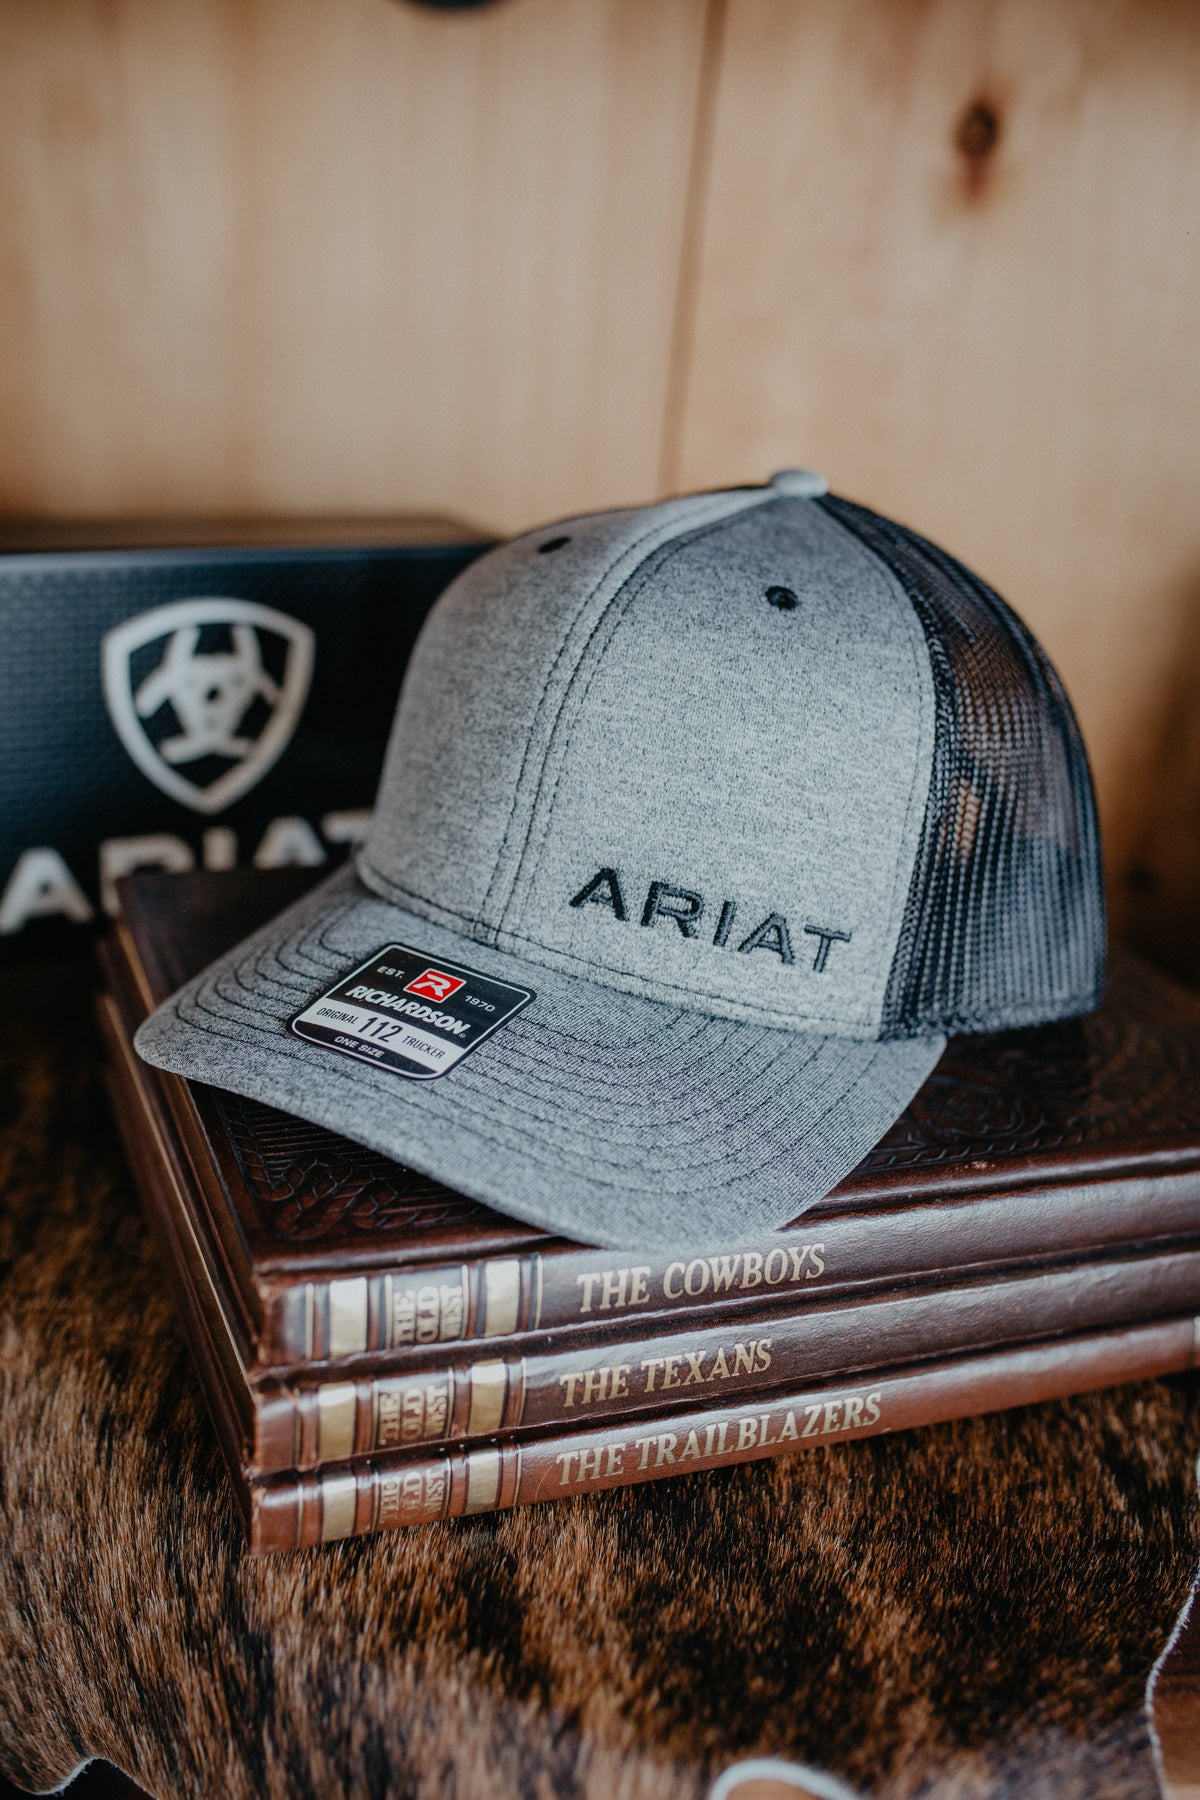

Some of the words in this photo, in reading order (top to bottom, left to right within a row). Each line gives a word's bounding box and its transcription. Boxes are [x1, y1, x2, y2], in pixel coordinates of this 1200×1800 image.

[0, 810, 376, 934] ARIA
[569, 867, 852, 973] ARIAT
[376, 965, 403, 979] EST.
[465, 995, 496, 1012] 1970
[316, 1007, 359, 1025] ORIGINAL
[357, 1016, 403, 1043] 112
[402, 1034, 446, 1060] TRUCKER
[334, 1035, 359, 1049] ONE
[361, 1044, 385, 1059] SIZE
[576, 1265, 651, 1313] THE
[662, 1243, 826, 1300] COWBOYS
[559, 1363, 630, 1408] THE
[640, 1339, 773, 1393] TEXANS
[556, 1442, 627, 1486] THE
[635, 1393, 882, 1471] TRAILBLAZERS
